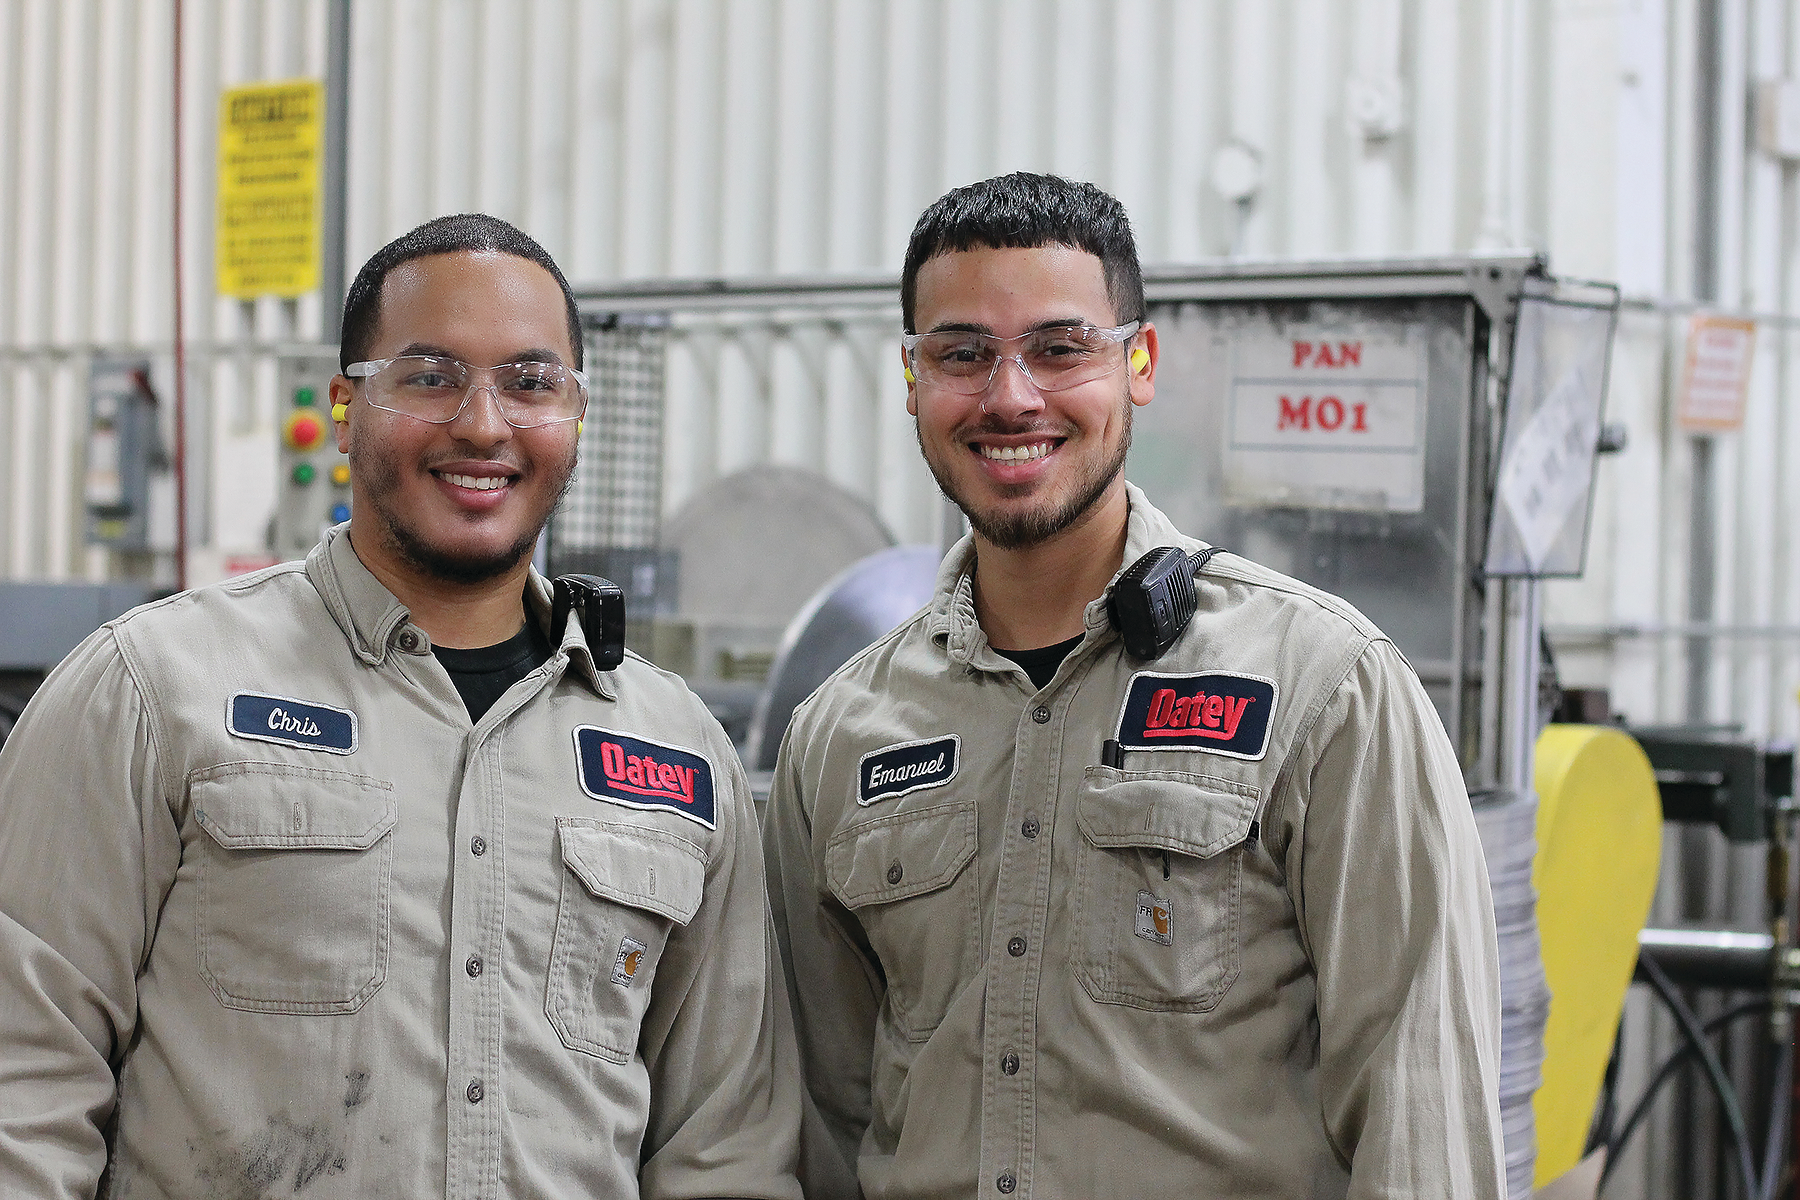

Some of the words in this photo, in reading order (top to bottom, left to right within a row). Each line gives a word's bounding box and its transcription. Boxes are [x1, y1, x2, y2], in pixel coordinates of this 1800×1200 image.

[1292, 340, 1363, 369] PAN
[267, 707, 321, 736] Chris
[1143, 688, 1249, 741] Oatey
[600, 741, 695, 804] Oatey
[868, 752, 946, 789] Emanuel
[1140, 905, 1153, 918] FR
